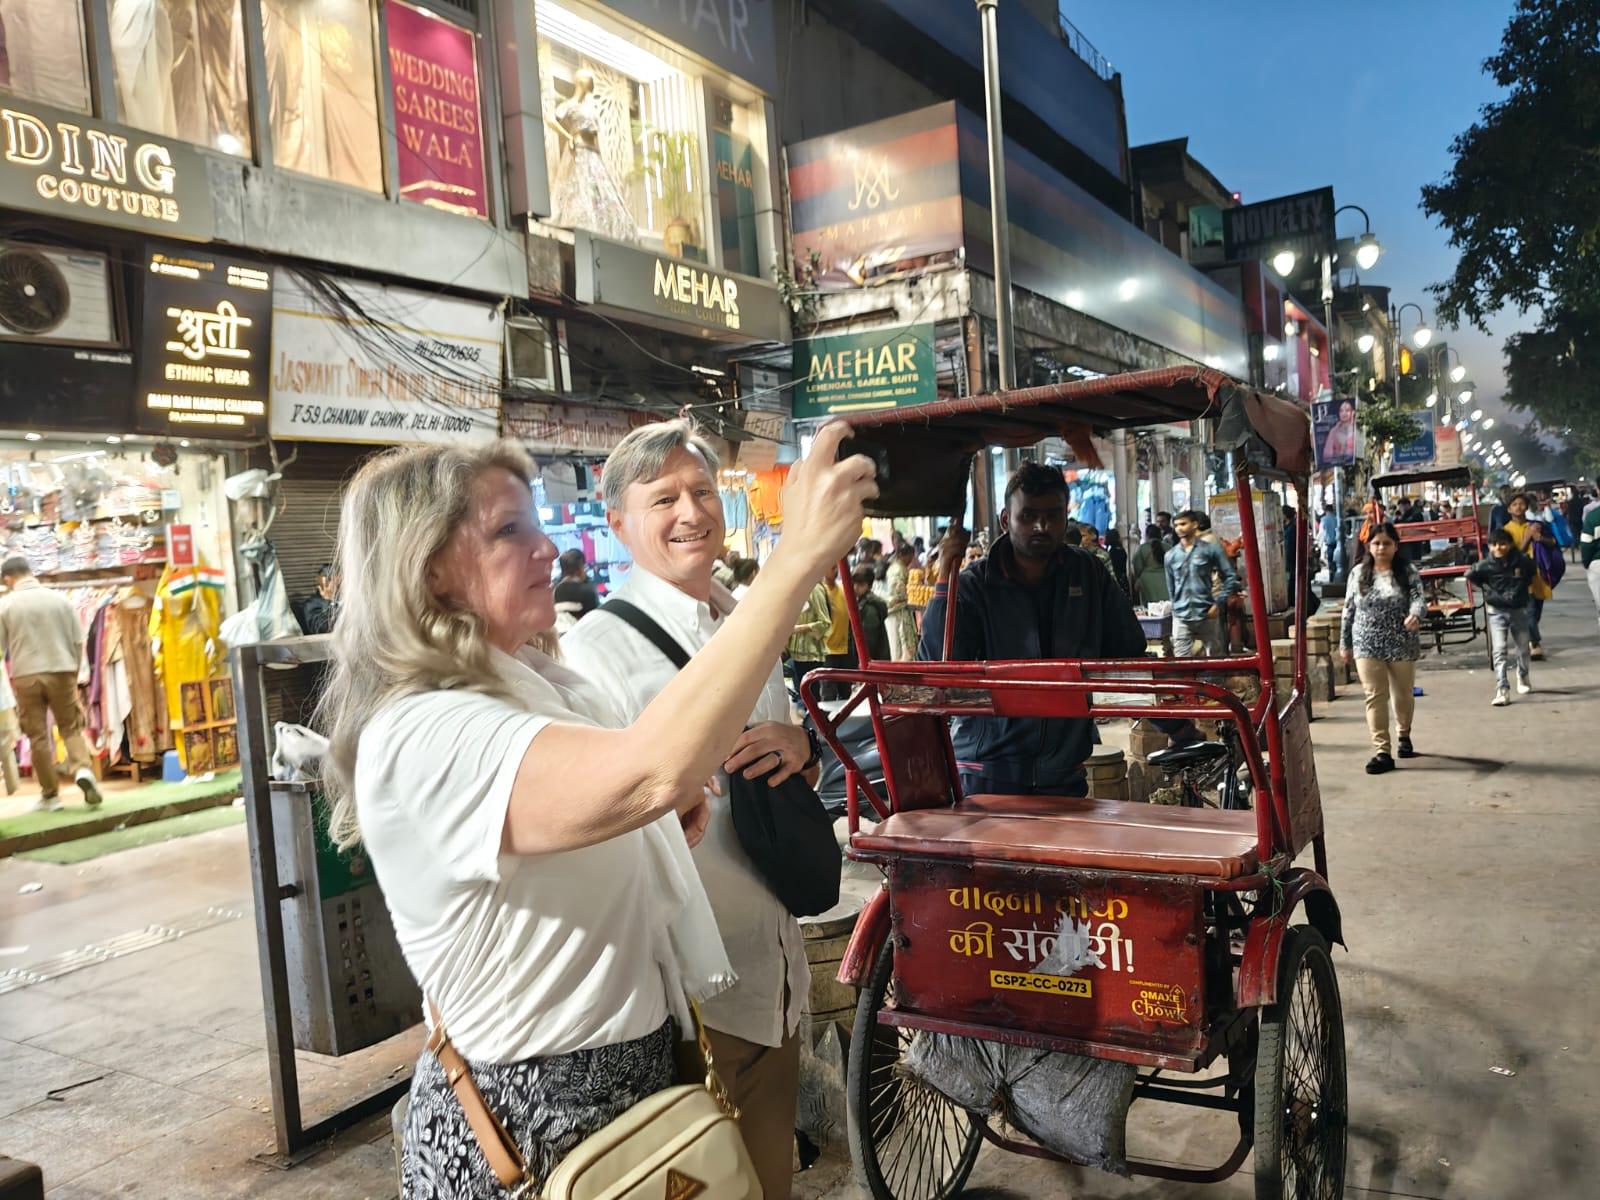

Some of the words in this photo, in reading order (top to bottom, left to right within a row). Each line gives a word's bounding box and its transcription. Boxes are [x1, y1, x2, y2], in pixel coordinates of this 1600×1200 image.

[388, 48, 474, 101] WEDDING
[396, 85, 475, 134] SAREES
[1, 109, 176, 194] DING
[403, 123, 472, 168] WALA
[36, 174, 180, 222] COUTURE
[654, 258, 739, 314] MEHAR
[166, 300, 252, 360] श्रुती
[165, 363, 213, 383] ETHNIC
[214, 367, 250, 386] WEAR
[807, 342, 917, 382] MEHAR
[948, 921, 995, 959] की
[994, 974, 1088, 994] CSPZ-CC-0273
[1140, 990, 1180, 1003] OMAXE
